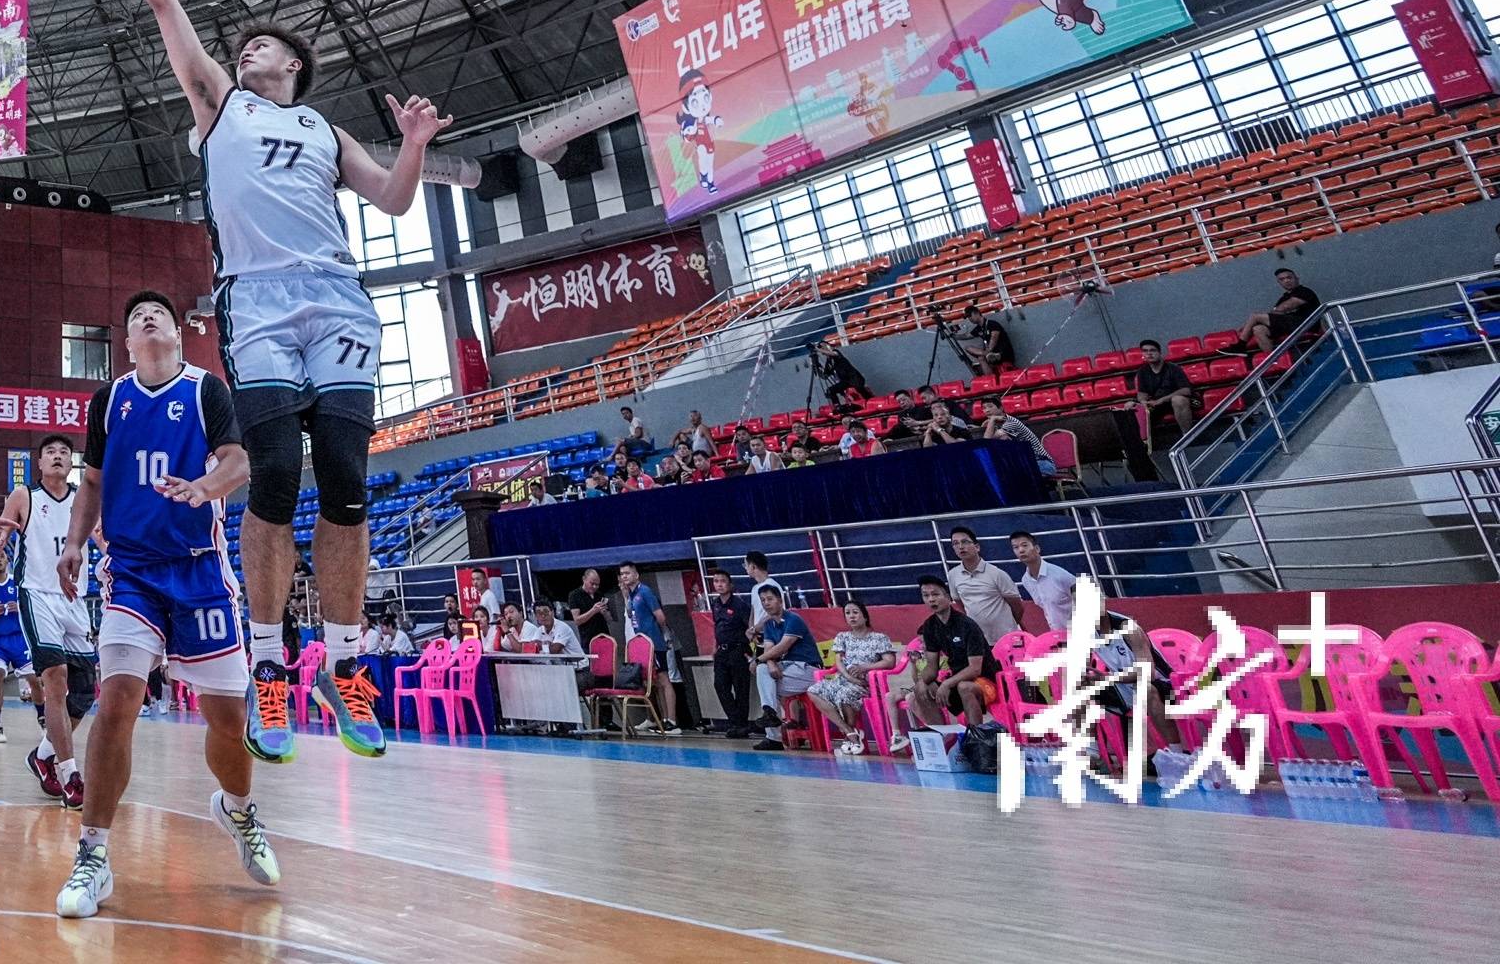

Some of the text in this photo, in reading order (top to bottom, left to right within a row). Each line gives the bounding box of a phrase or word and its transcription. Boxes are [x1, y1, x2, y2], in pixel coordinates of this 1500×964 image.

[260, 136, 305, 169] 77
[522, 244, 678, 323] 恒朋体育
[336, 337, 371, 370] 77
[136, 450, 169, 487] 10
[194, 608, 228, 640] 10
